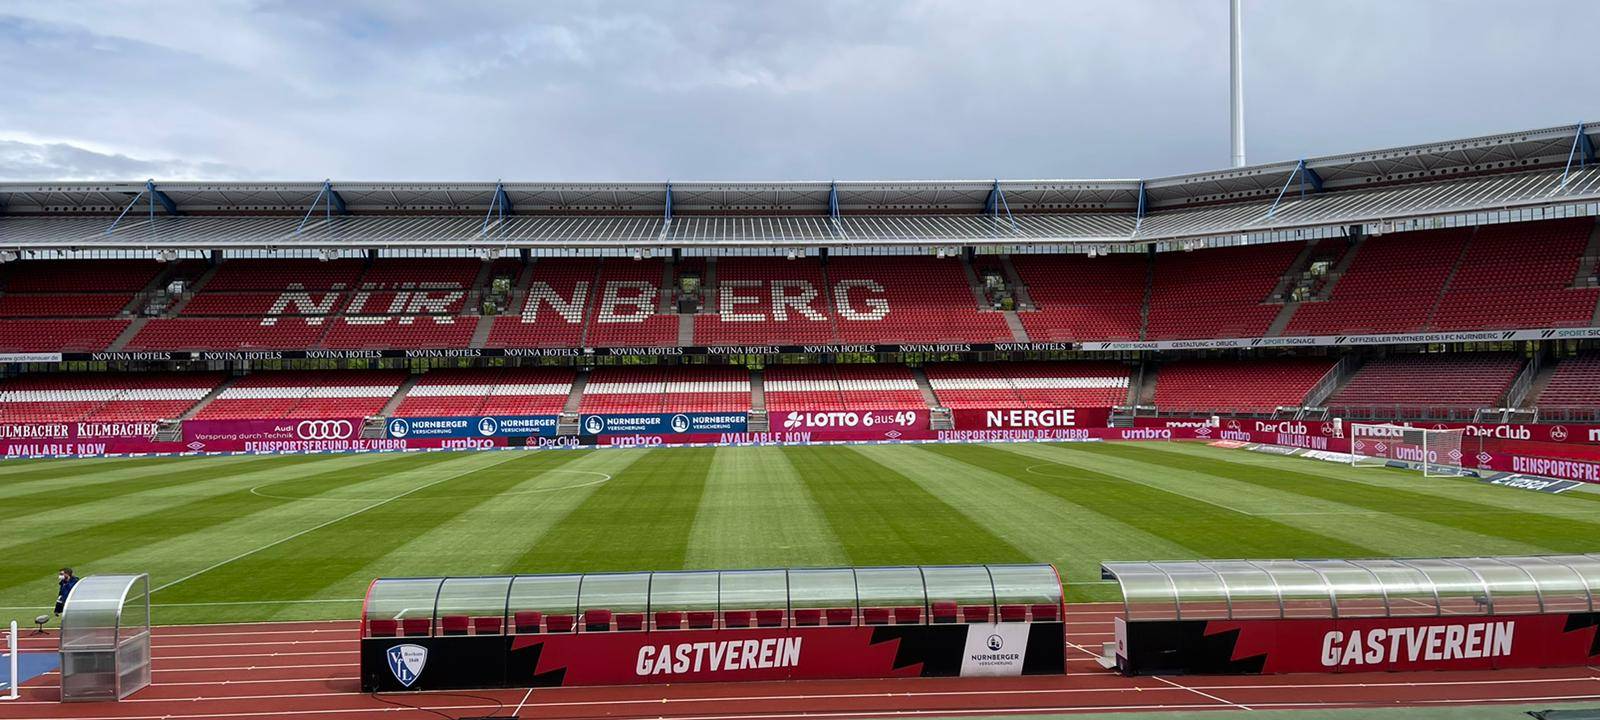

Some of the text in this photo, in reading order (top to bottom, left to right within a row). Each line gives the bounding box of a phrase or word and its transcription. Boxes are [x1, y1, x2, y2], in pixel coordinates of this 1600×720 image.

[504, 348, 579, 356] NOVINA HOTELS
[609, 347, 684, 355] NOVINA HOTELS
[707, 346, 780, 354] NOVINA HOTELS
[804, 345, 839, 353] NOVINA
[899, 344, 971, 352] NOVINA HOTELS
[92, 352, 171, 360] NOVINA HOTELS
[204, 351, 282, 360] NOVINA HOTELS
[306, 350, 382, 359] NOVINA HOTELS
[412, 420, 468, 428] NÜRNBERGER
[501, 418, 556, 427] NÜRNBERGER
[607, 417, 661, 425] NÜRNBERGER
[692, 415, 746, 424] NÜRNBERGER
[806, 412, 859, 427] LOTTO
[0, 424, 69, 437] ULMBACHER
[77, 422, 158, 436] KULMBACHER
[1121, 427, 1171, 439] umbro
[1256, 421, 1277, 432] Der
[1279, 421, 1307, 435] Club
[1466, 424, 1531, 440] Der Club
[611, 434, 662, 445] umbro
[720, 432, 782, 443] AVAILABLE
[785, 431, 812, 442] NOW
[938, 429, 1089, 440] DEINSPORTSFREUND.DE/UMBRO
[1220, 428, 1251, 441] umbro
[245, 438, 407, 451] DEINSPORTSFREUND.DE/UMBRO
[441, 437, 494, 449] umbro
[538, 436, 556, 446] Der
[557, 436, 580, 446] Club
[1277, 433, 1310, 448] AVAILABLE
[1311, 436, 1328, 450] NOW
[7, 443, 73, 455] AVAILABLE
[78, 443, 106, 454] NOW
[1321, 621, 1515, 667] GASTVEREIN
[636, 636, 802, 676] GASTVEREIN
[971, 653, 1020, 661] NÜRNBERGER
